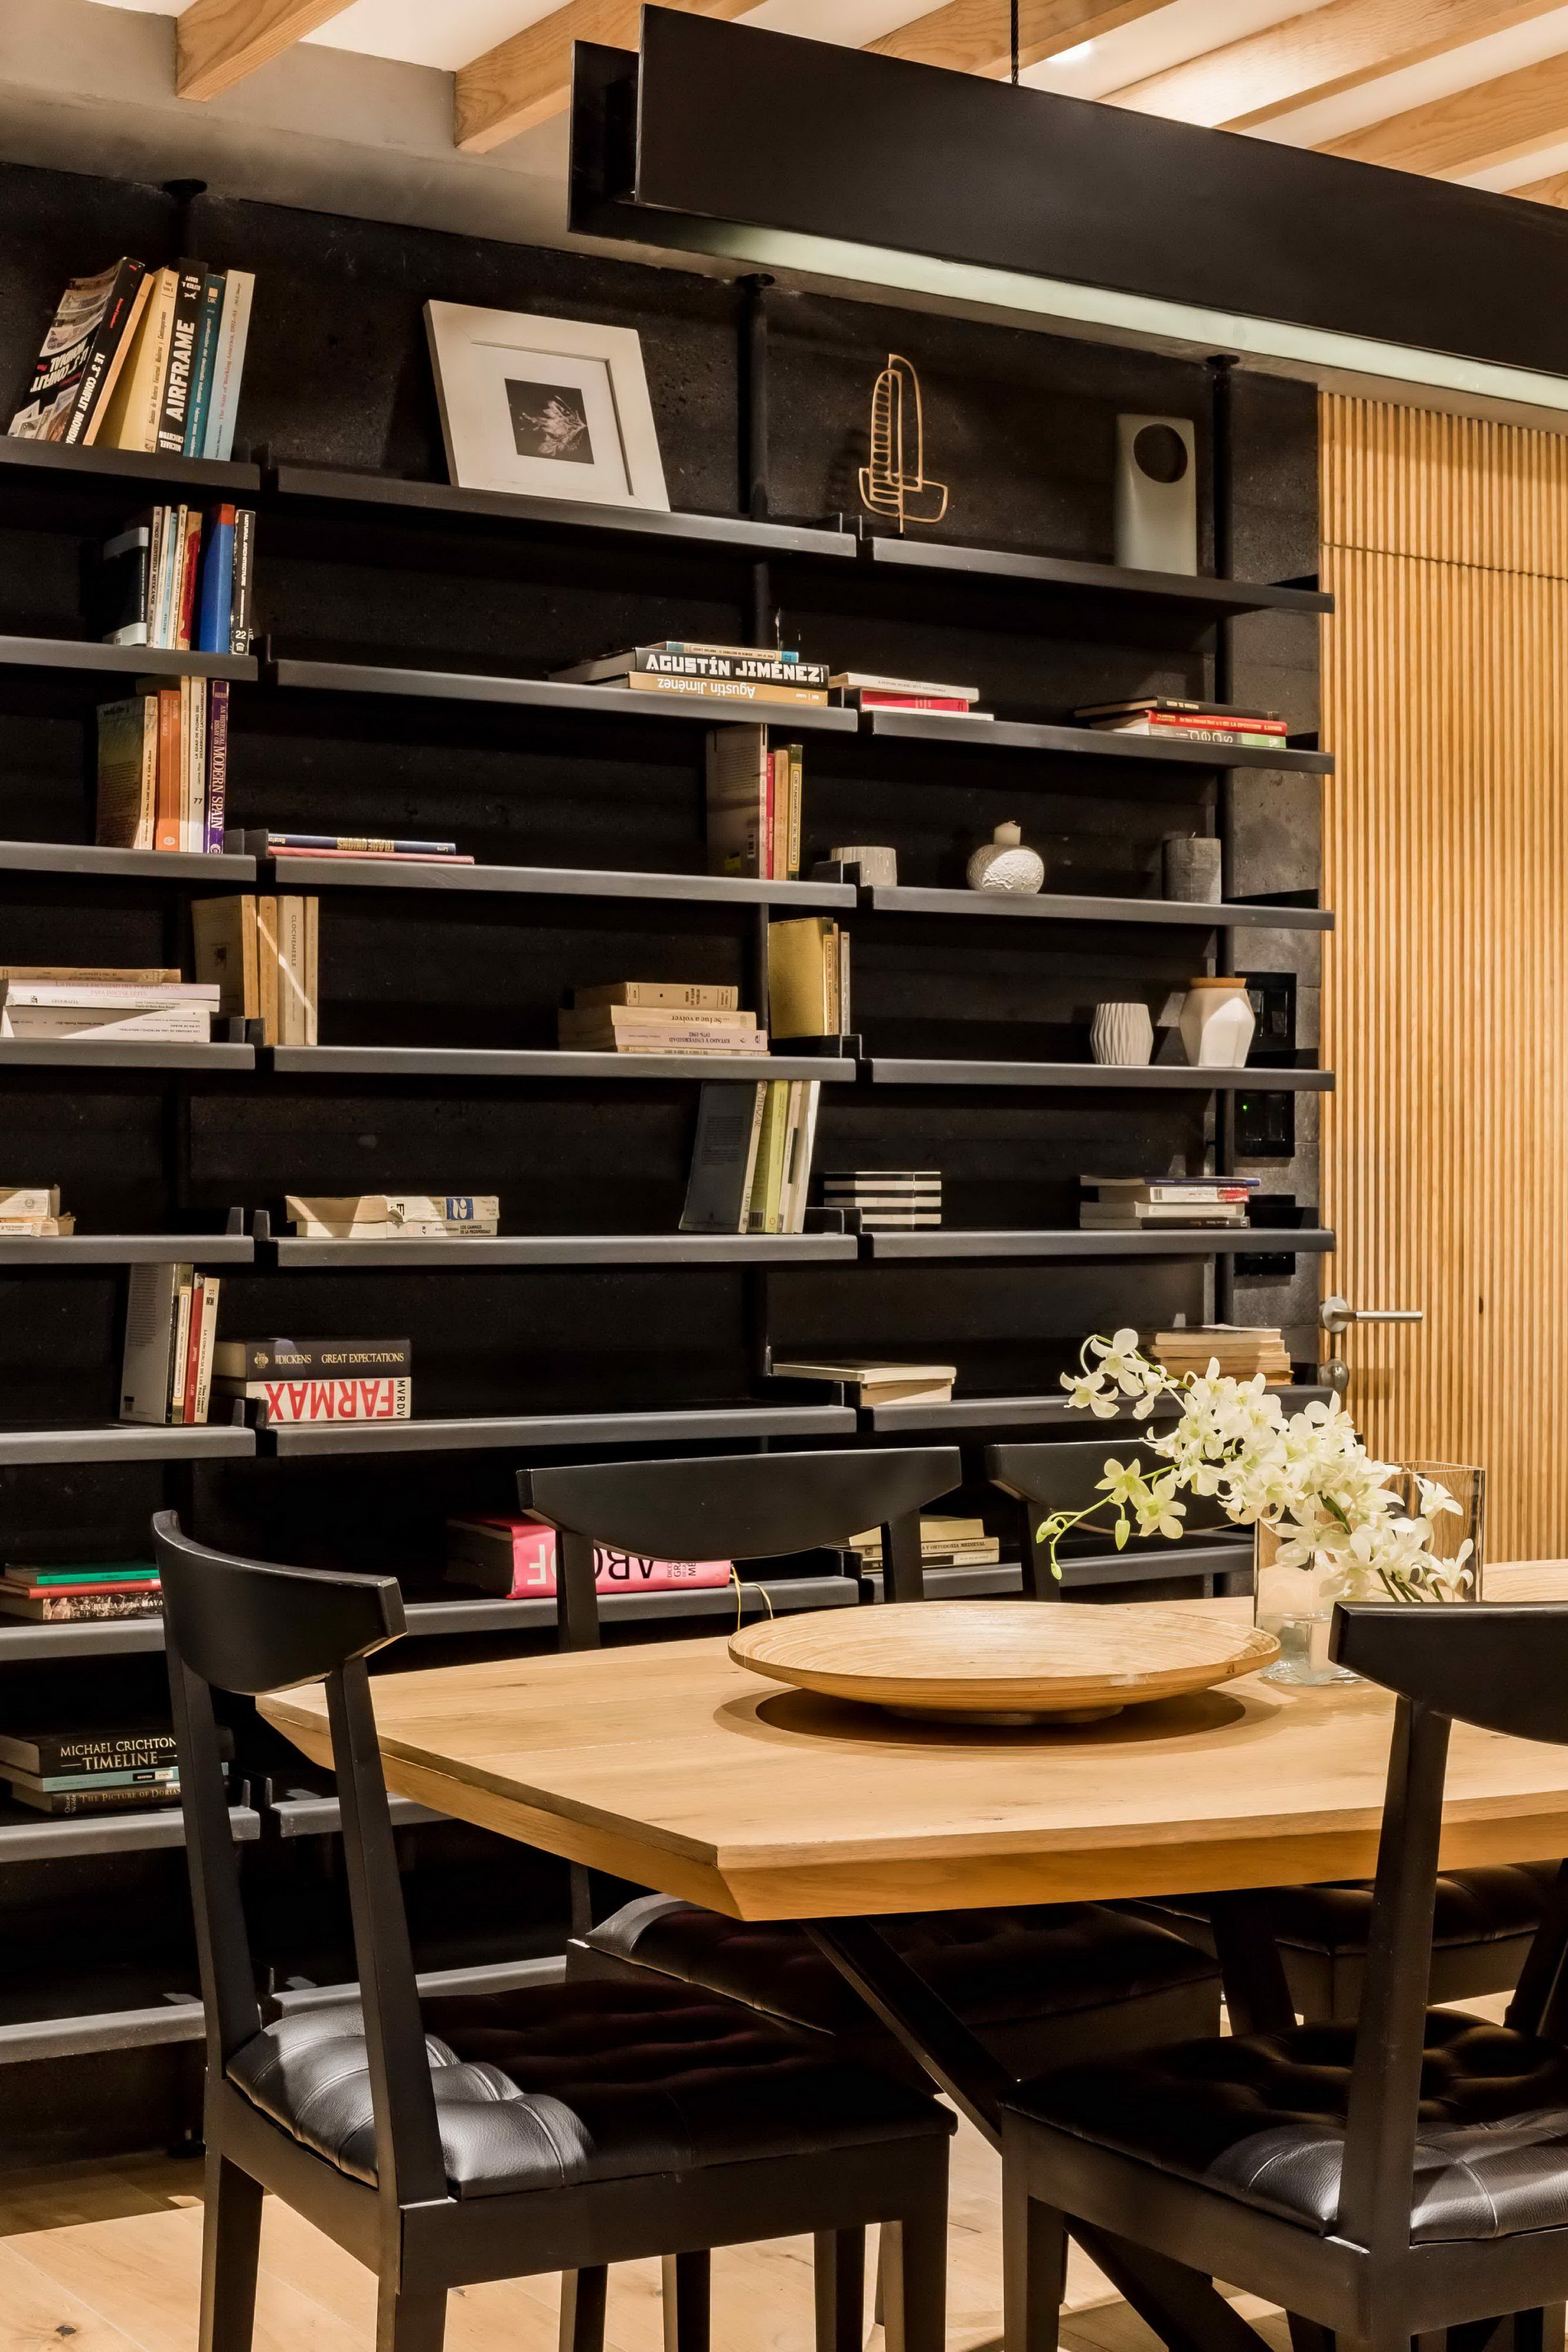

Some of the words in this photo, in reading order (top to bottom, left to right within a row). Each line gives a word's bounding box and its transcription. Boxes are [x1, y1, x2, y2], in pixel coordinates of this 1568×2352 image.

[93, 352, 105, 365] LE
[199, 358, 207, 381] desarrollo
[32, 364, 68, 392] CONFLIT
[166, 320, 195, 421] AIRFRAME
[222, 360, 232, 385] Working
[76, 375, 98, 411] CONFLIT
[63, 410, 85, 446] MONDIA
[159, 431, 183, 443] CRICHTON
[161, 440, 181, 452] MICHAEL
[235, 630, 246, 639] 22
[646, 654, 730, 676] AGUSTÍN
[656, 677, 707, 694] Jiménez
[709, 679, 755, 699] Agustín
[210, 746, 225, 793] MODERN
[210, 796, 223, 829] SPAIN
[279, 1354, 311, 1364] DICKENS
[321, 1354, 346, 1363] GREAT
[349, 1352, 404, 1363] EXPECTATIONS
[264, 1381, 394, 1420] FARMAX
[397, 1380, 406, 1416] MVRDV
[60, 1743, 113, 1756] MICHAEL
[115, 1737, 176, 1751] CRICHTON
[82, 1751, 158, 1770] TIMELINE
[102, 1790, 135, 1801] PICTURE
